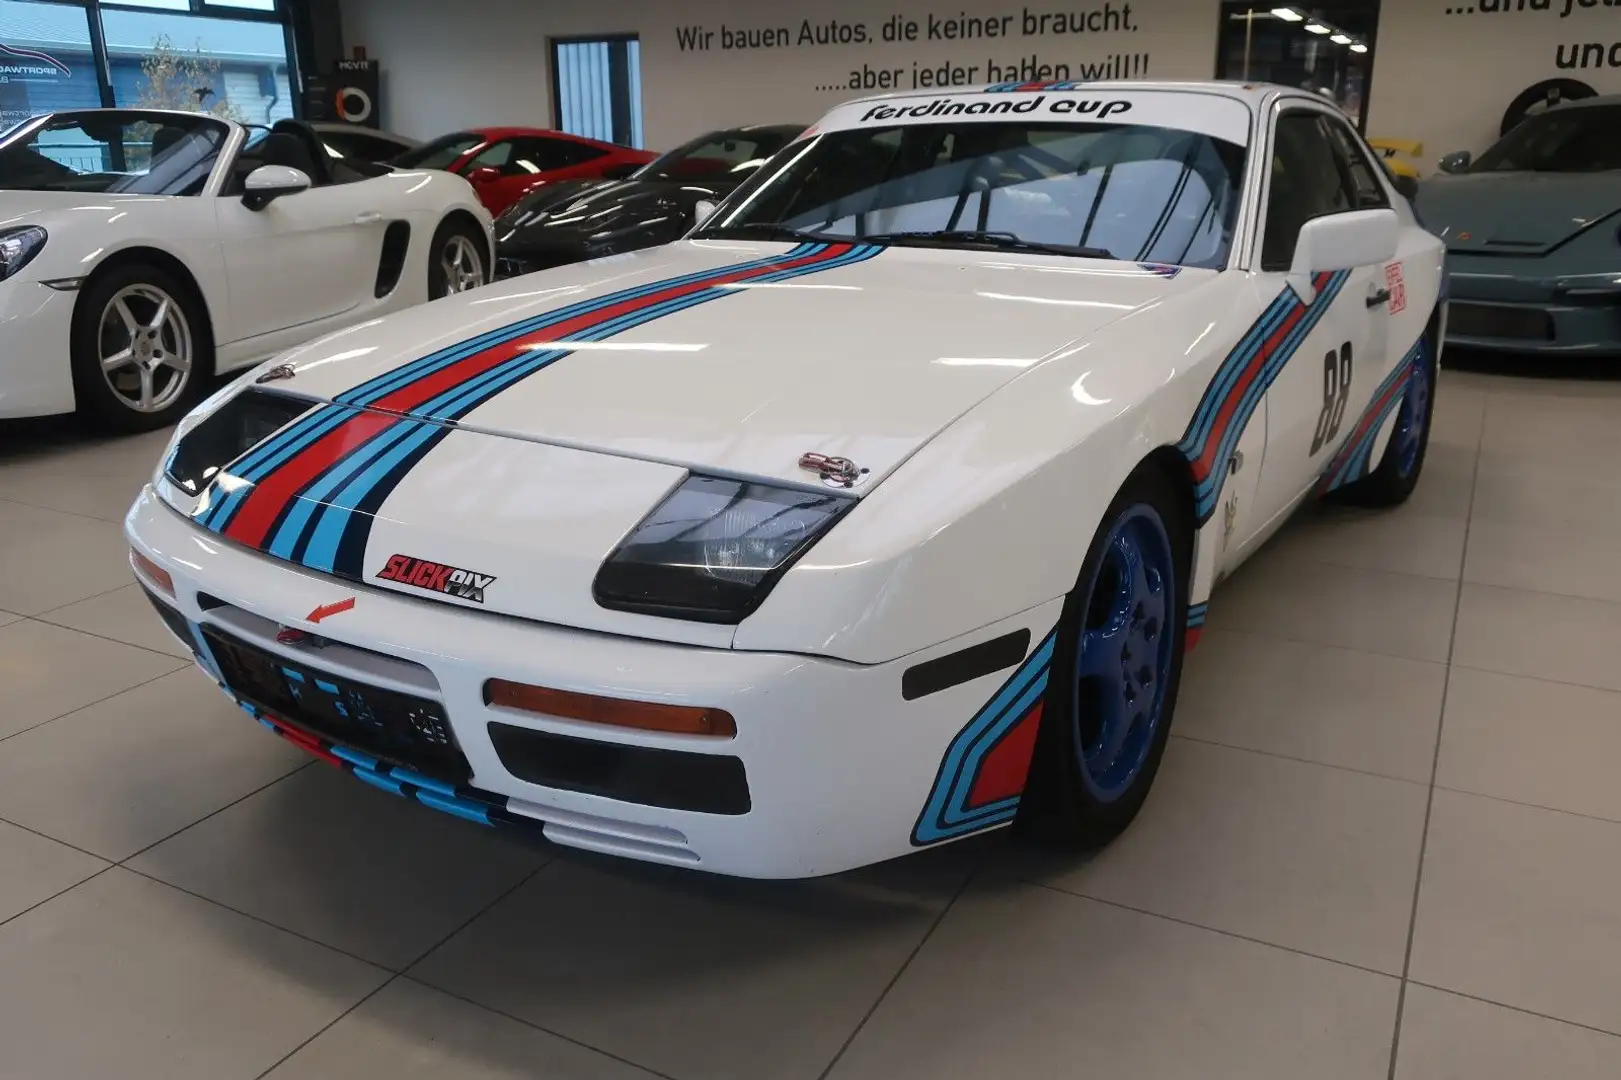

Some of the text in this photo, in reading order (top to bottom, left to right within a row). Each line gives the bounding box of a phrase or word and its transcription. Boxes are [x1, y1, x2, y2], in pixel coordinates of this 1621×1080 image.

[676, 3, 1138, 51] Wir bauen Autos, die keiner braucht,
[912, 61, 979, 90] jeder
[987, 54, 1070, 83] haben
[861, 96, 1133, 121] ferdinand cup
[1309, 340, 1352, 458] 88
[376, 554, 497, 603] SLICKPIX
